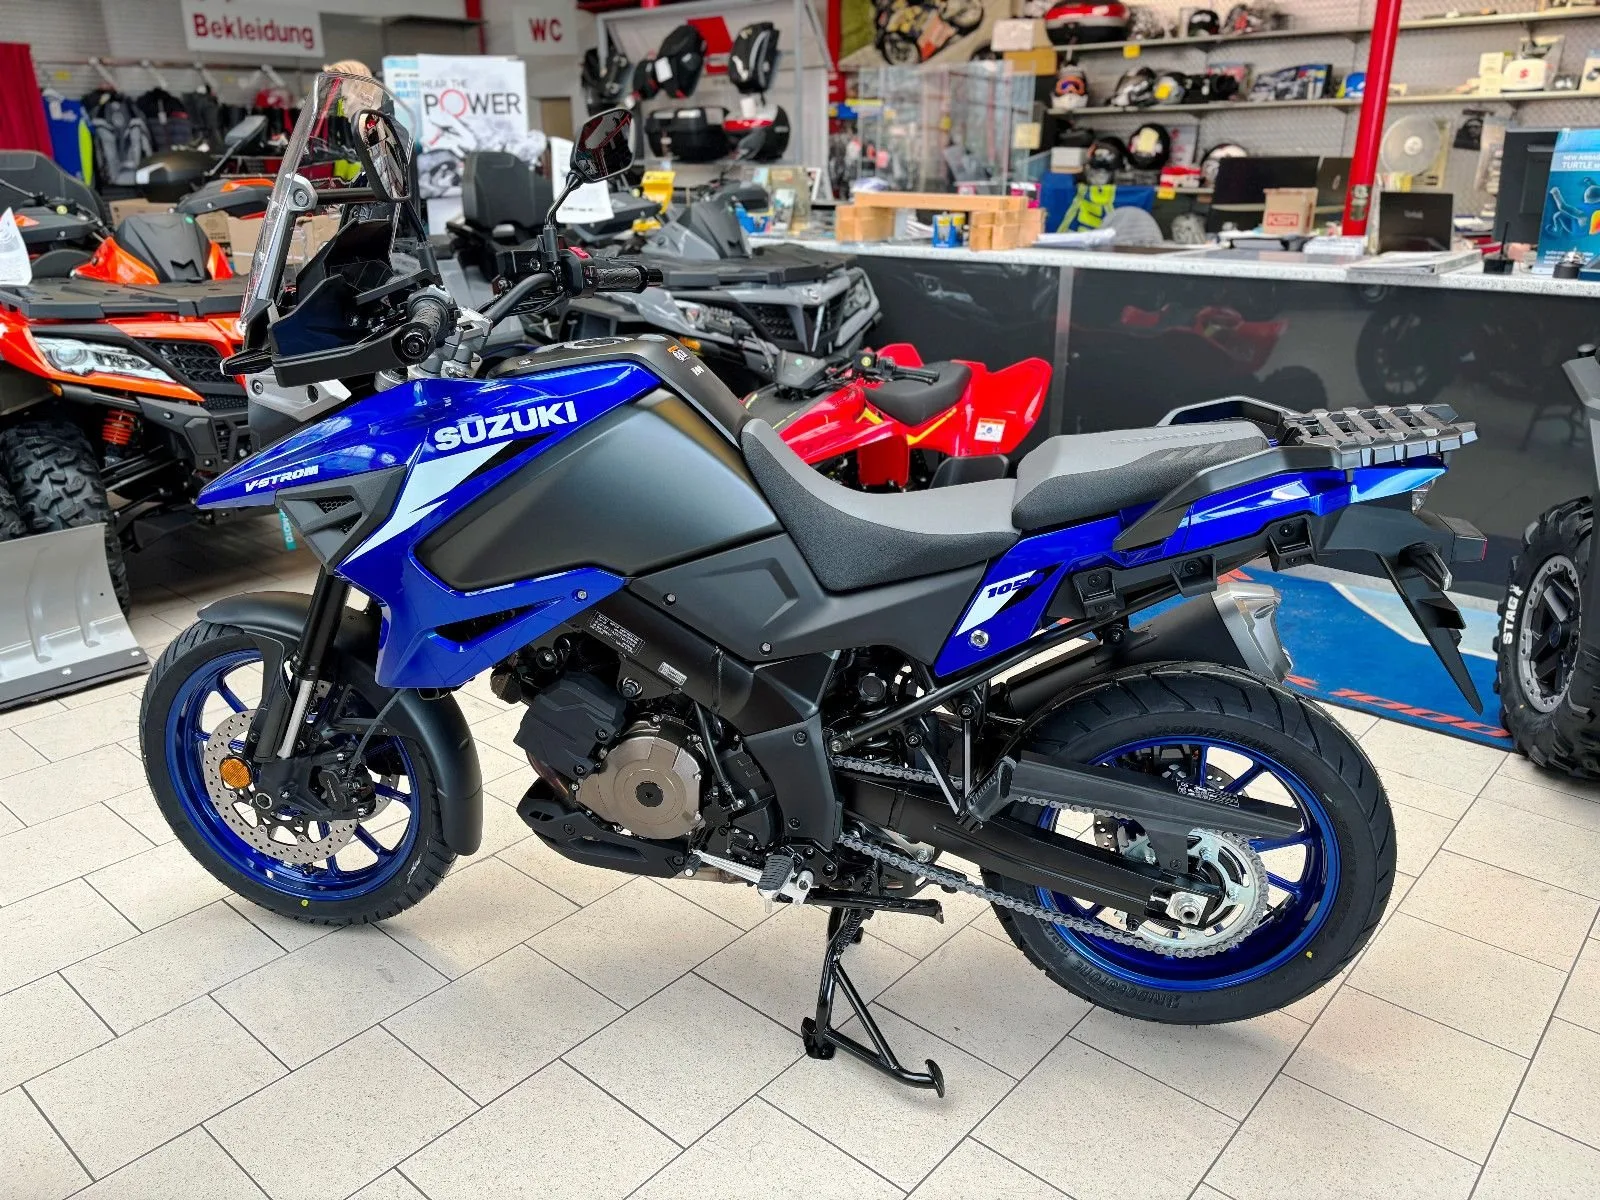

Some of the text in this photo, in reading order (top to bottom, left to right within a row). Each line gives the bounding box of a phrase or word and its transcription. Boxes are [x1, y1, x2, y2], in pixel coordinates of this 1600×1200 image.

[193, 13, 315, 50] Bekleidung
[528, 17, 563, 42] WC
[423, 89, 522, 118] POWER
[1561, 161, 1593, 169] TURTLE
[434, 400, 578, 451] SUZUKI
[244, 464, 319, 493] V-STROM
[1502, 595, 1520, 645] STAG
[1328, 687, 1513, 738] 1000
